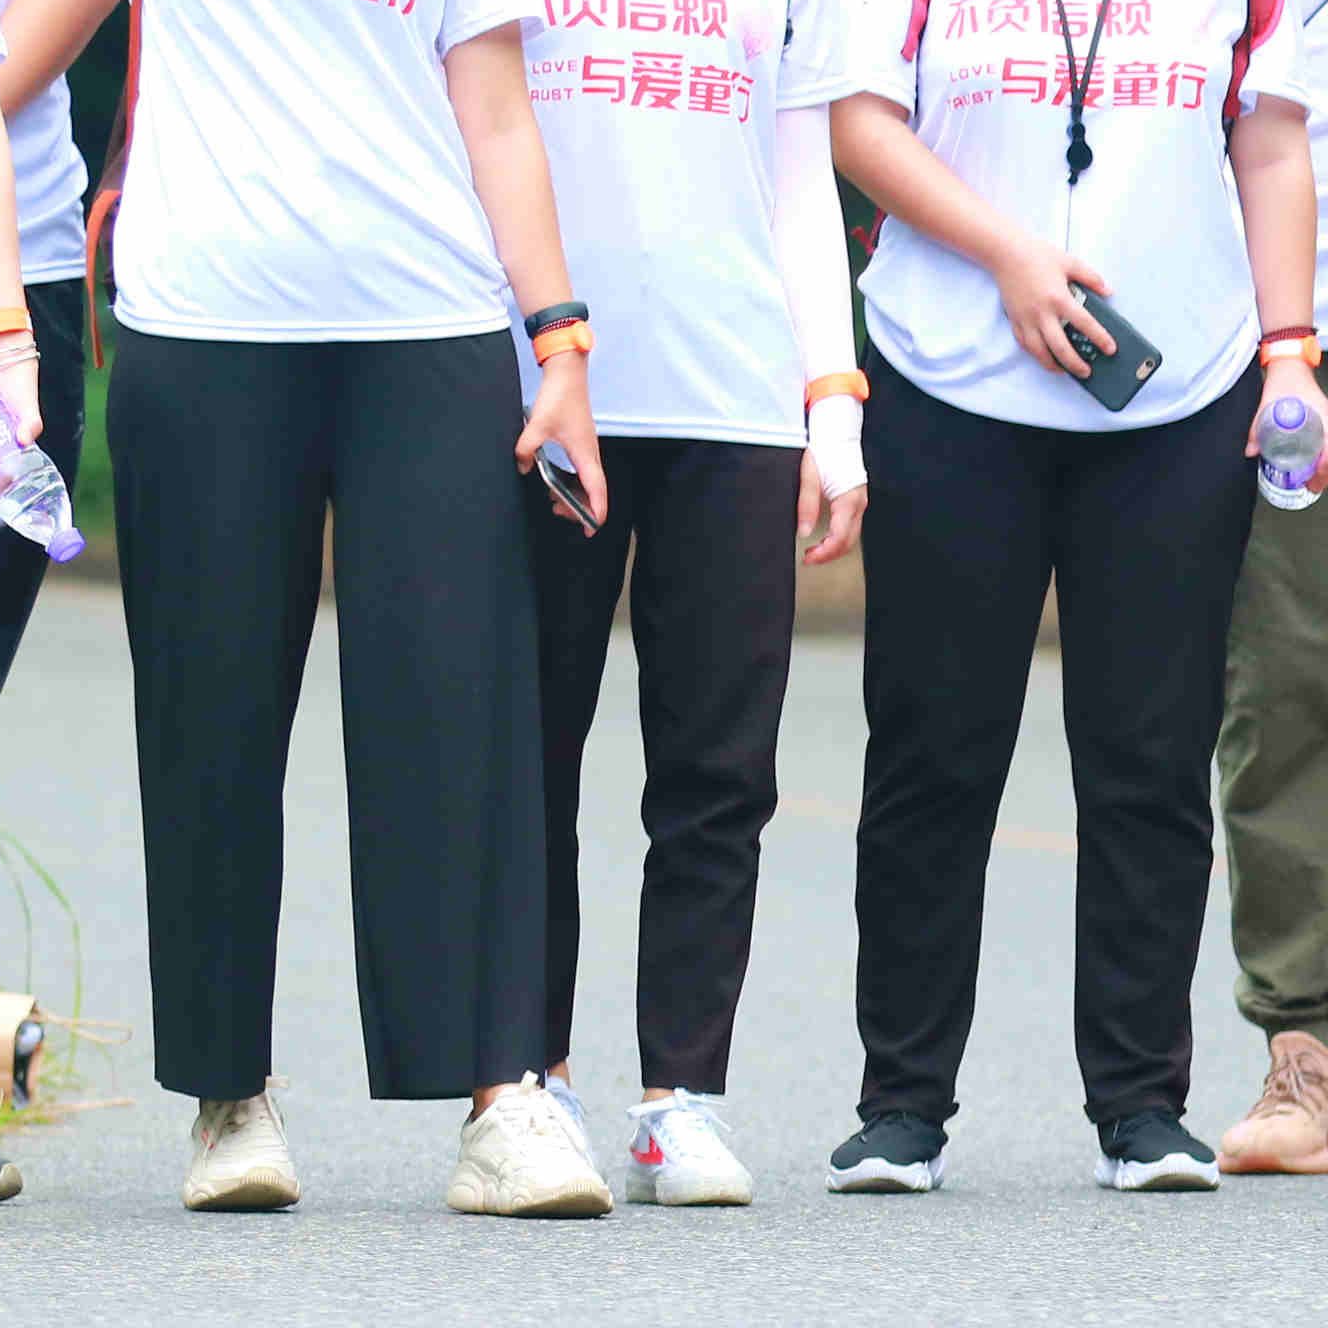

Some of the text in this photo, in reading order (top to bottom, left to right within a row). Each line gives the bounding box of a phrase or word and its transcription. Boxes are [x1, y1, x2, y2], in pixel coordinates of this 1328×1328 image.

[532, 59, 578, 74] LOVE
[1001, 54, 1207, 110] 与爱童行
